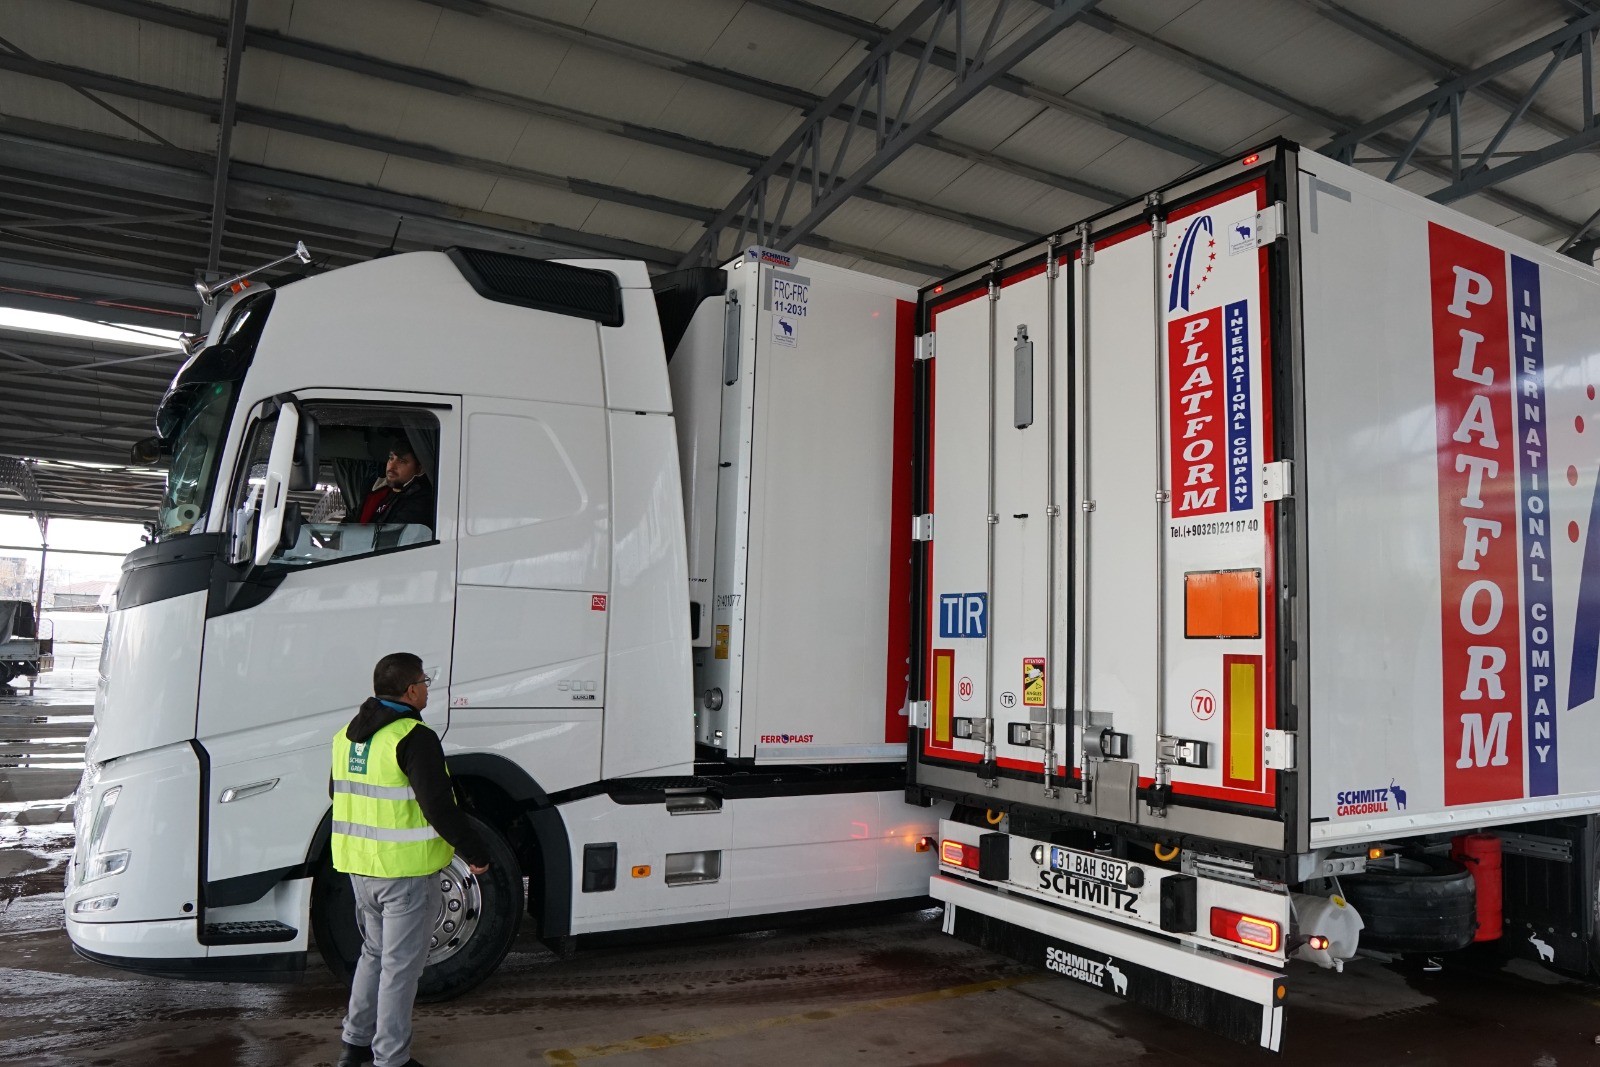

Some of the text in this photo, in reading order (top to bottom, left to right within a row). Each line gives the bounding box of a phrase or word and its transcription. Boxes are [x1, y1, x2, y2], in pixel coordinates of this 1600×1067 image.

[761, 250, 791, 262] SCHMITZ
[774, 279, 809, 304] FRC-FRC
[774, 300, 807, 317] 11-2031
[1179, 317, 1220, 512] PLATFORM
[1231, 308, 1249, 504] INTERNATIONAL COMPANY
[1447, 265, 1512, 769] PLATFORM
[1520, 289, 1551, 764] INTERNATIONAL COMPANY
[943, 596, 984, 634] TIR
[556, 679, 597, 691] 500
[959, 682, 972, 696] 80
[1195, 696, 1213, 714] 70
[761, 734, 814, 744] FERROPLAST
[1337, 788, 1388, 806] SCHMITZ
[1337, 802, 1388, 816] CARGOBULL
[1058, 851, 1070, 870] 31
[1075, 855, 1096, 877] BAH
[1101, 861, 1123, 883] 992
[1040, 870, 1139, 914] SCHMITZ
[1045, 959, 1104, 988] CARGOBULL
[1046, 946, 1104, 977] SCHMITZ
